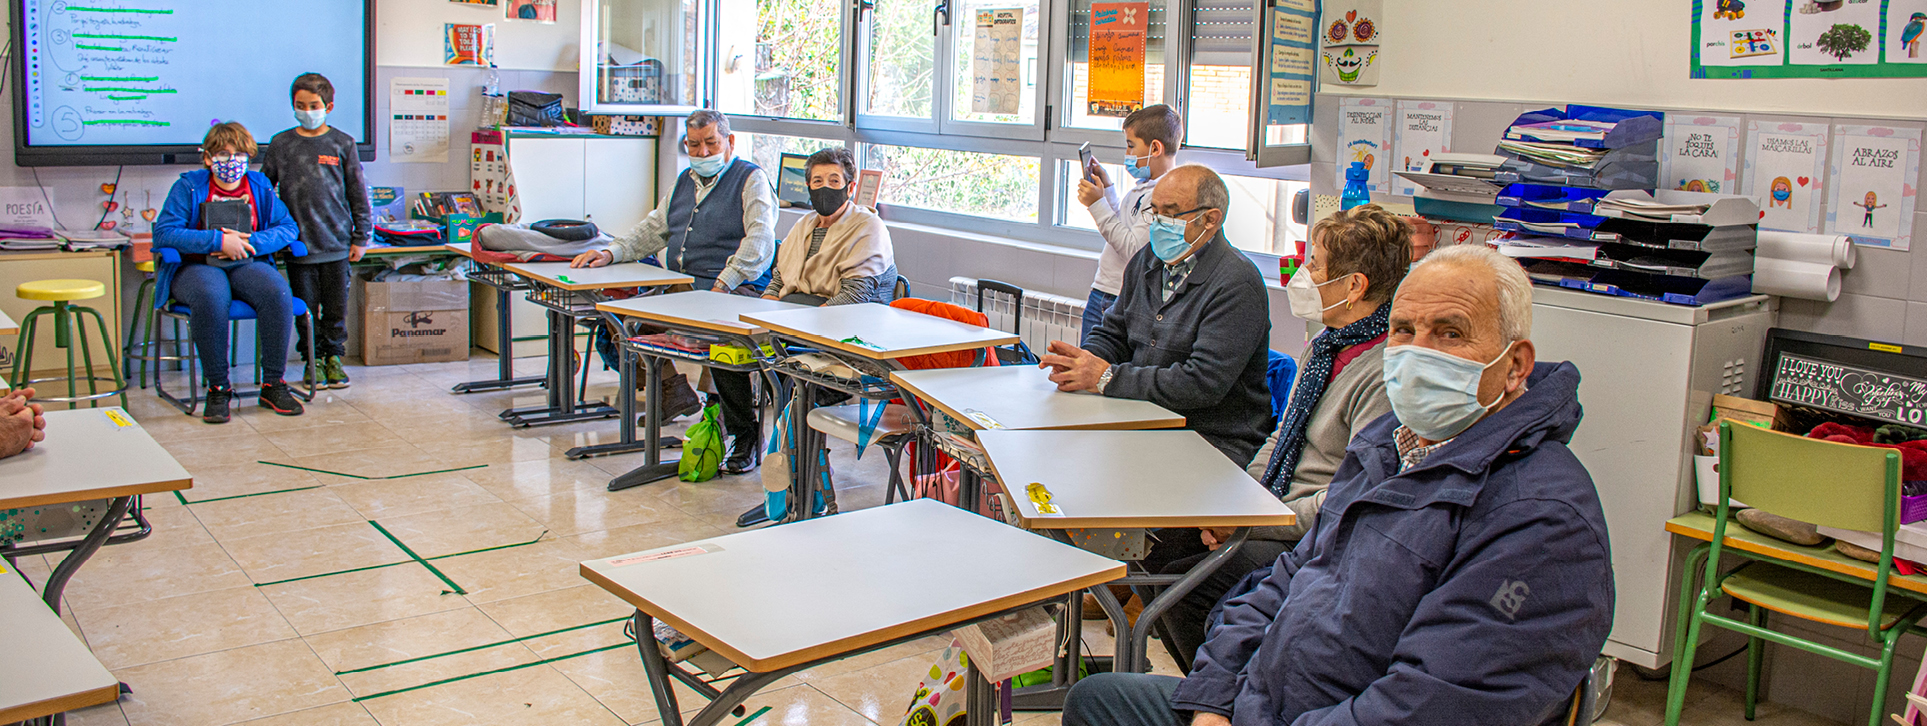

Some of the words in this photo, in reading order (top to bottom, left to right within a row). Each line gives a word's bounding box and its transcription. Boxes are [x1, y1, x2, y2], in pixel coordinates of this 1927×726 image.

[61, 112, 78, 132] 5
[1703, 134, 1712, 142] TE
[1767, 138, 1794, 146] USAMOS
[1795, 139, 1809, 147] LAS
[1685, 140, 1714, 150] TOQUES
[1762, 144, 1812, 154] MASCARILLAS
[1679, 148, 1690, 156] LA
[1852, 147, 1898, 160] ABRAZOS
[1851, 156, 1866, 166] AL
[1868, 157, 1894, 168] AIRE
[6, 201, 44, 215] POESÍA
[392, 328, 447, 338] Panamar
[1782, 358, 1789, 370] I
[1788, 359, 1819, 376] LOVE
[1820, 364, 1844, 380] YOU
[1778, 383, 1833, 406] HAPPY
